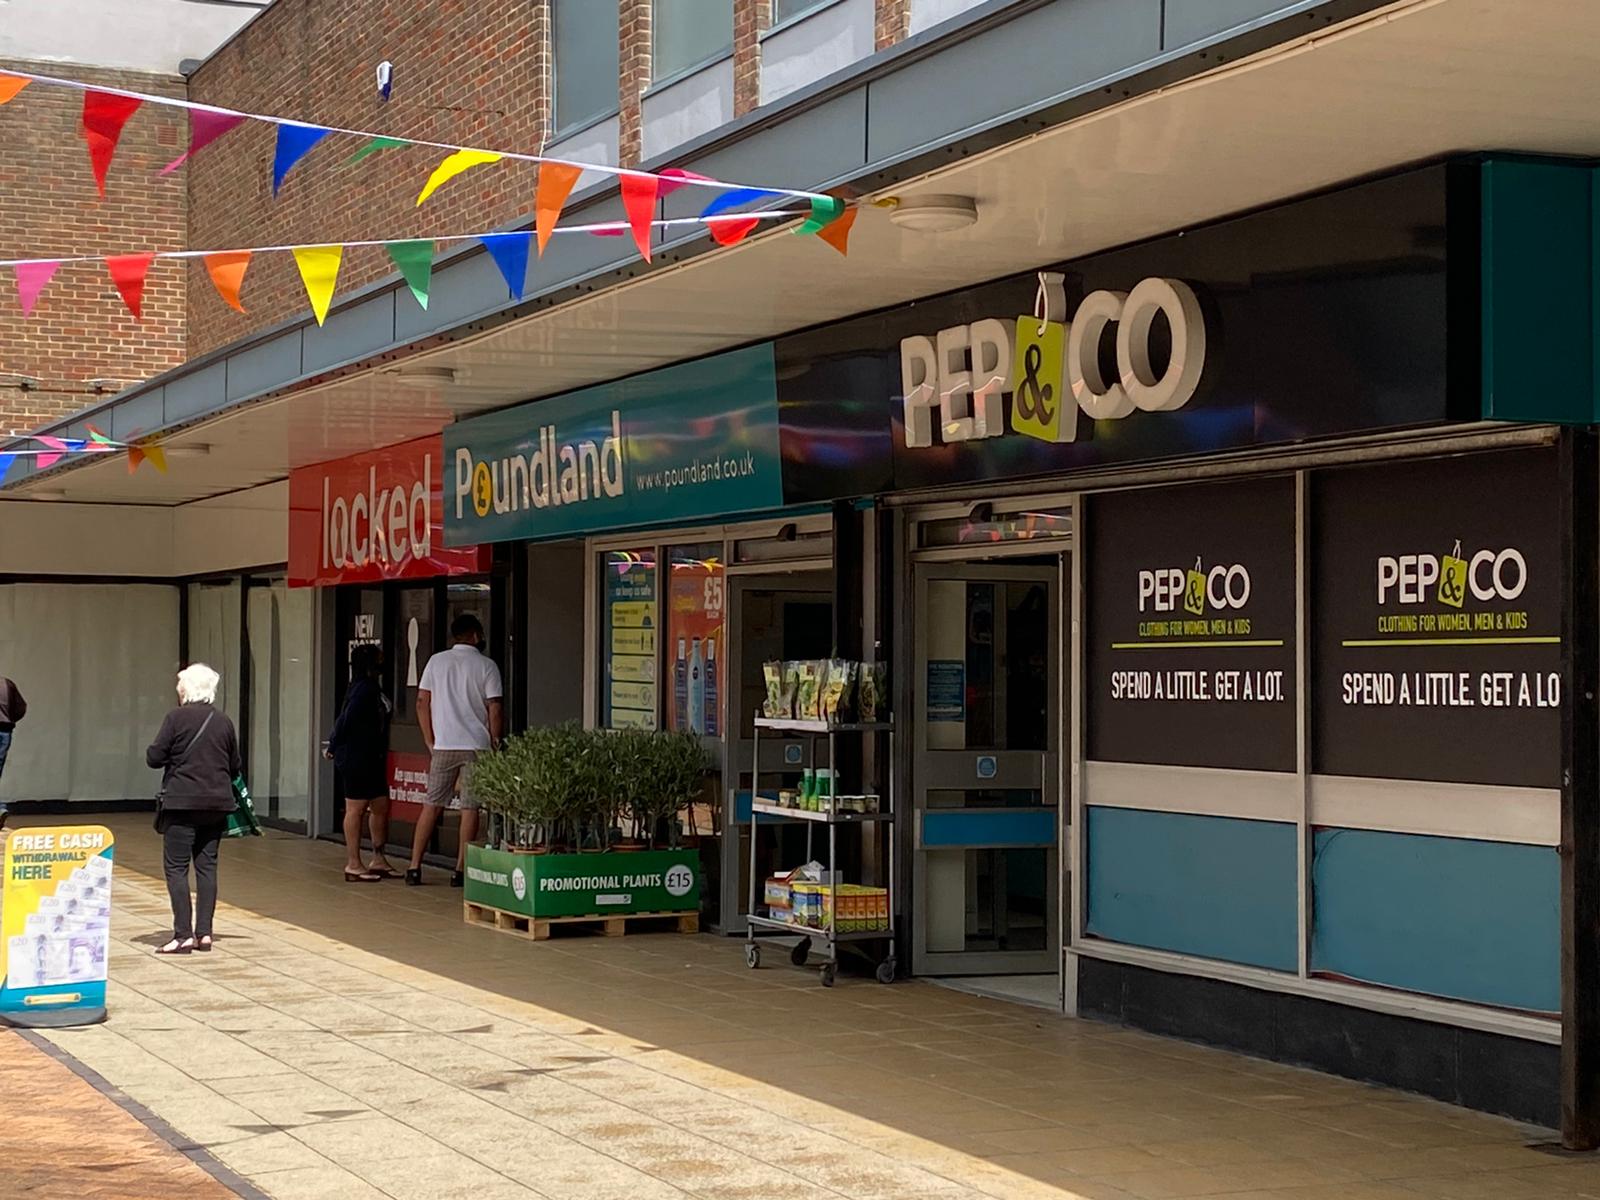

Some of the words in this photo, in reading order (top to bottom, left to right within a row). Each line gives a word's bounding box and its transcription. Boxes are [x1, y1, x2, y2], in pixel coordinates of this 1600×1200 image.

[900, 272, 1207, 448] PEP&CO
[455, 410, 625, 519] Poundland
[635, 449, 755, 492] www.poundland.co.uk
[322, 453, 431, 569] locked
[1139, 556, 1250, 615] PEP&CO
[1378, 539, 1528, 608] PEP&CO
[703, 576, 722, 610] £5
[354, 614, 375, 639] NEW
[1139, 620, 1169, 636] CLOTHING
[1169, 620, 1183, 636] FOR
[1211, 619, 1227, 635] MEN
[1234, 618, 1250, 635] KIDS
[1378, 615, 1417, 633] CLOTHING
[1419, 614, 1436, 631] FOR
[1438, 613, 1473, 632] WOMEN,
[1474, 613, 1494, 630] MEN
[1496, 614, 1503, 630] &
[1505, 612, 1528, 629] KIDS
[1111, 671, 1151, 699] SPEND
[1154, 671, 1164, 699] A
[1166, 671, 1211, 700] LITTLE.
[1215, 670, 1240, 700] GET
[1243, 671, 1253, 700] A
[1256, 671, 1284, 701] LOT.
[1342, 672, 1394, 705] SPEND
[1399, 673, 1411, 705] A
[1415, 672, 1475, 706] LITTLE.
[1480, 672, 1513, 707] GET
[1518, 673, 1531, 707] A
[1536, 672, 1562, 707] LO
[12, 834, 55, 851] FREE
[59, 832, 105, 849] CASH
[12, 851, 87, 863] WITHDRAWALS
[12, 864, 52, 880] HERE
[540, 875, 620, 892] PROMOTIONAL
[623, 873, 661, 889] PLANTS
[667, 872, 691, 888] £15
